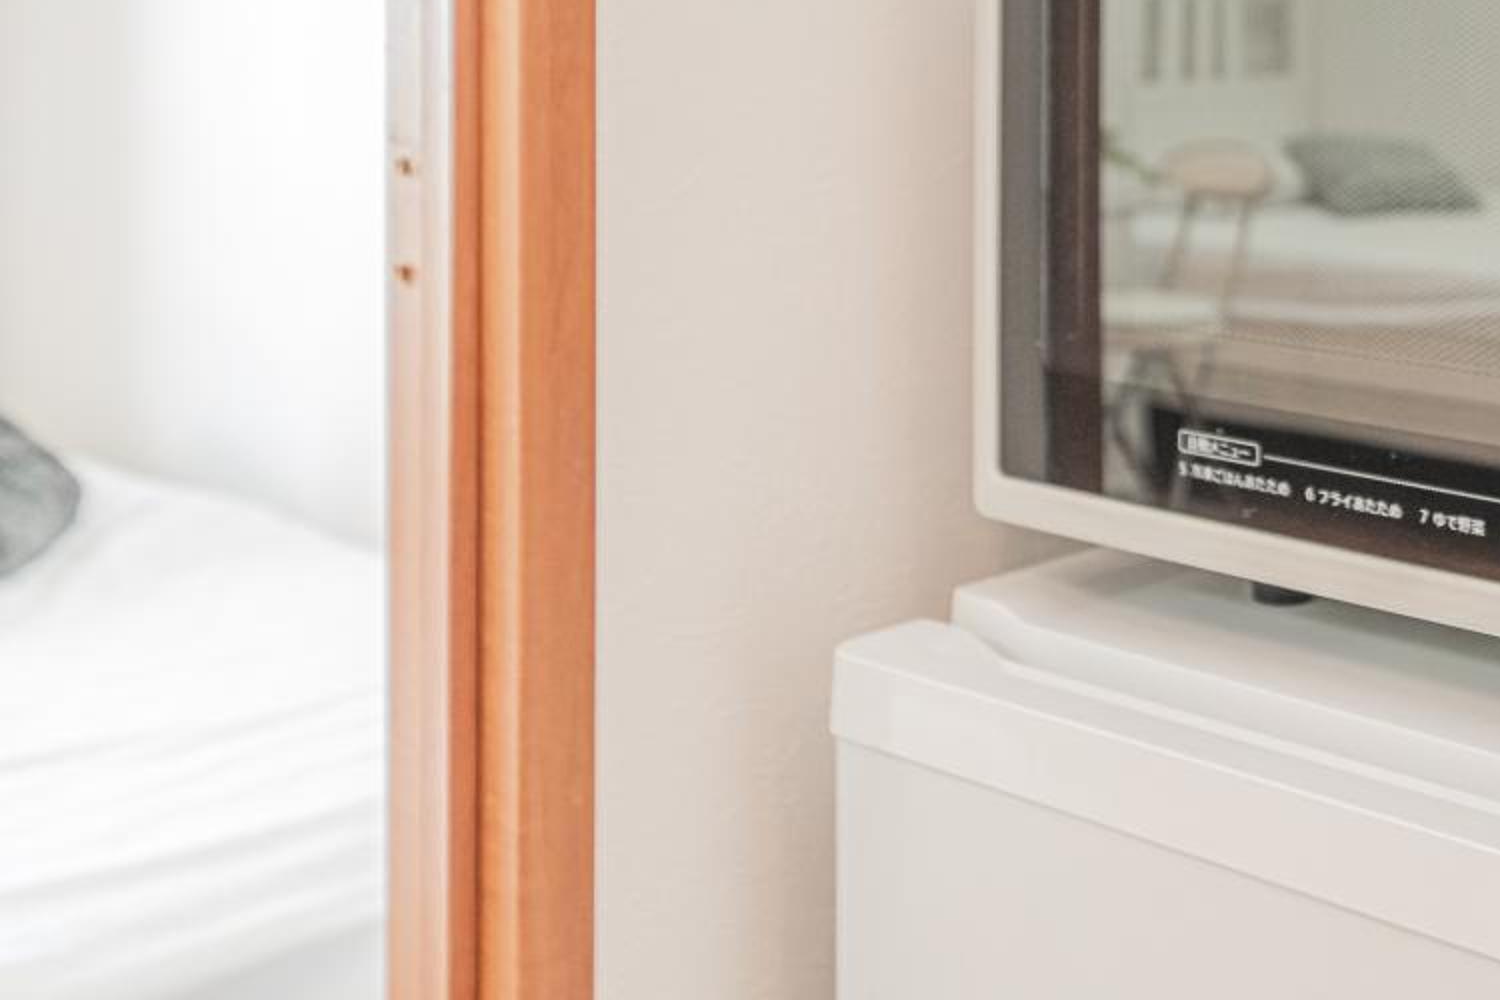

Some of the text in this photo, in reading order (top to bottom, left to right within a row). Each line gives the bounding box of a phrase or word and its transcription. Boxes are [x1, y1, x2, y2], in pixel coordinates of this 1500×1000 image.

[1304, 486, 1404, 520] 6 フライあたため
[1419, 508, 1430, 525] 7
